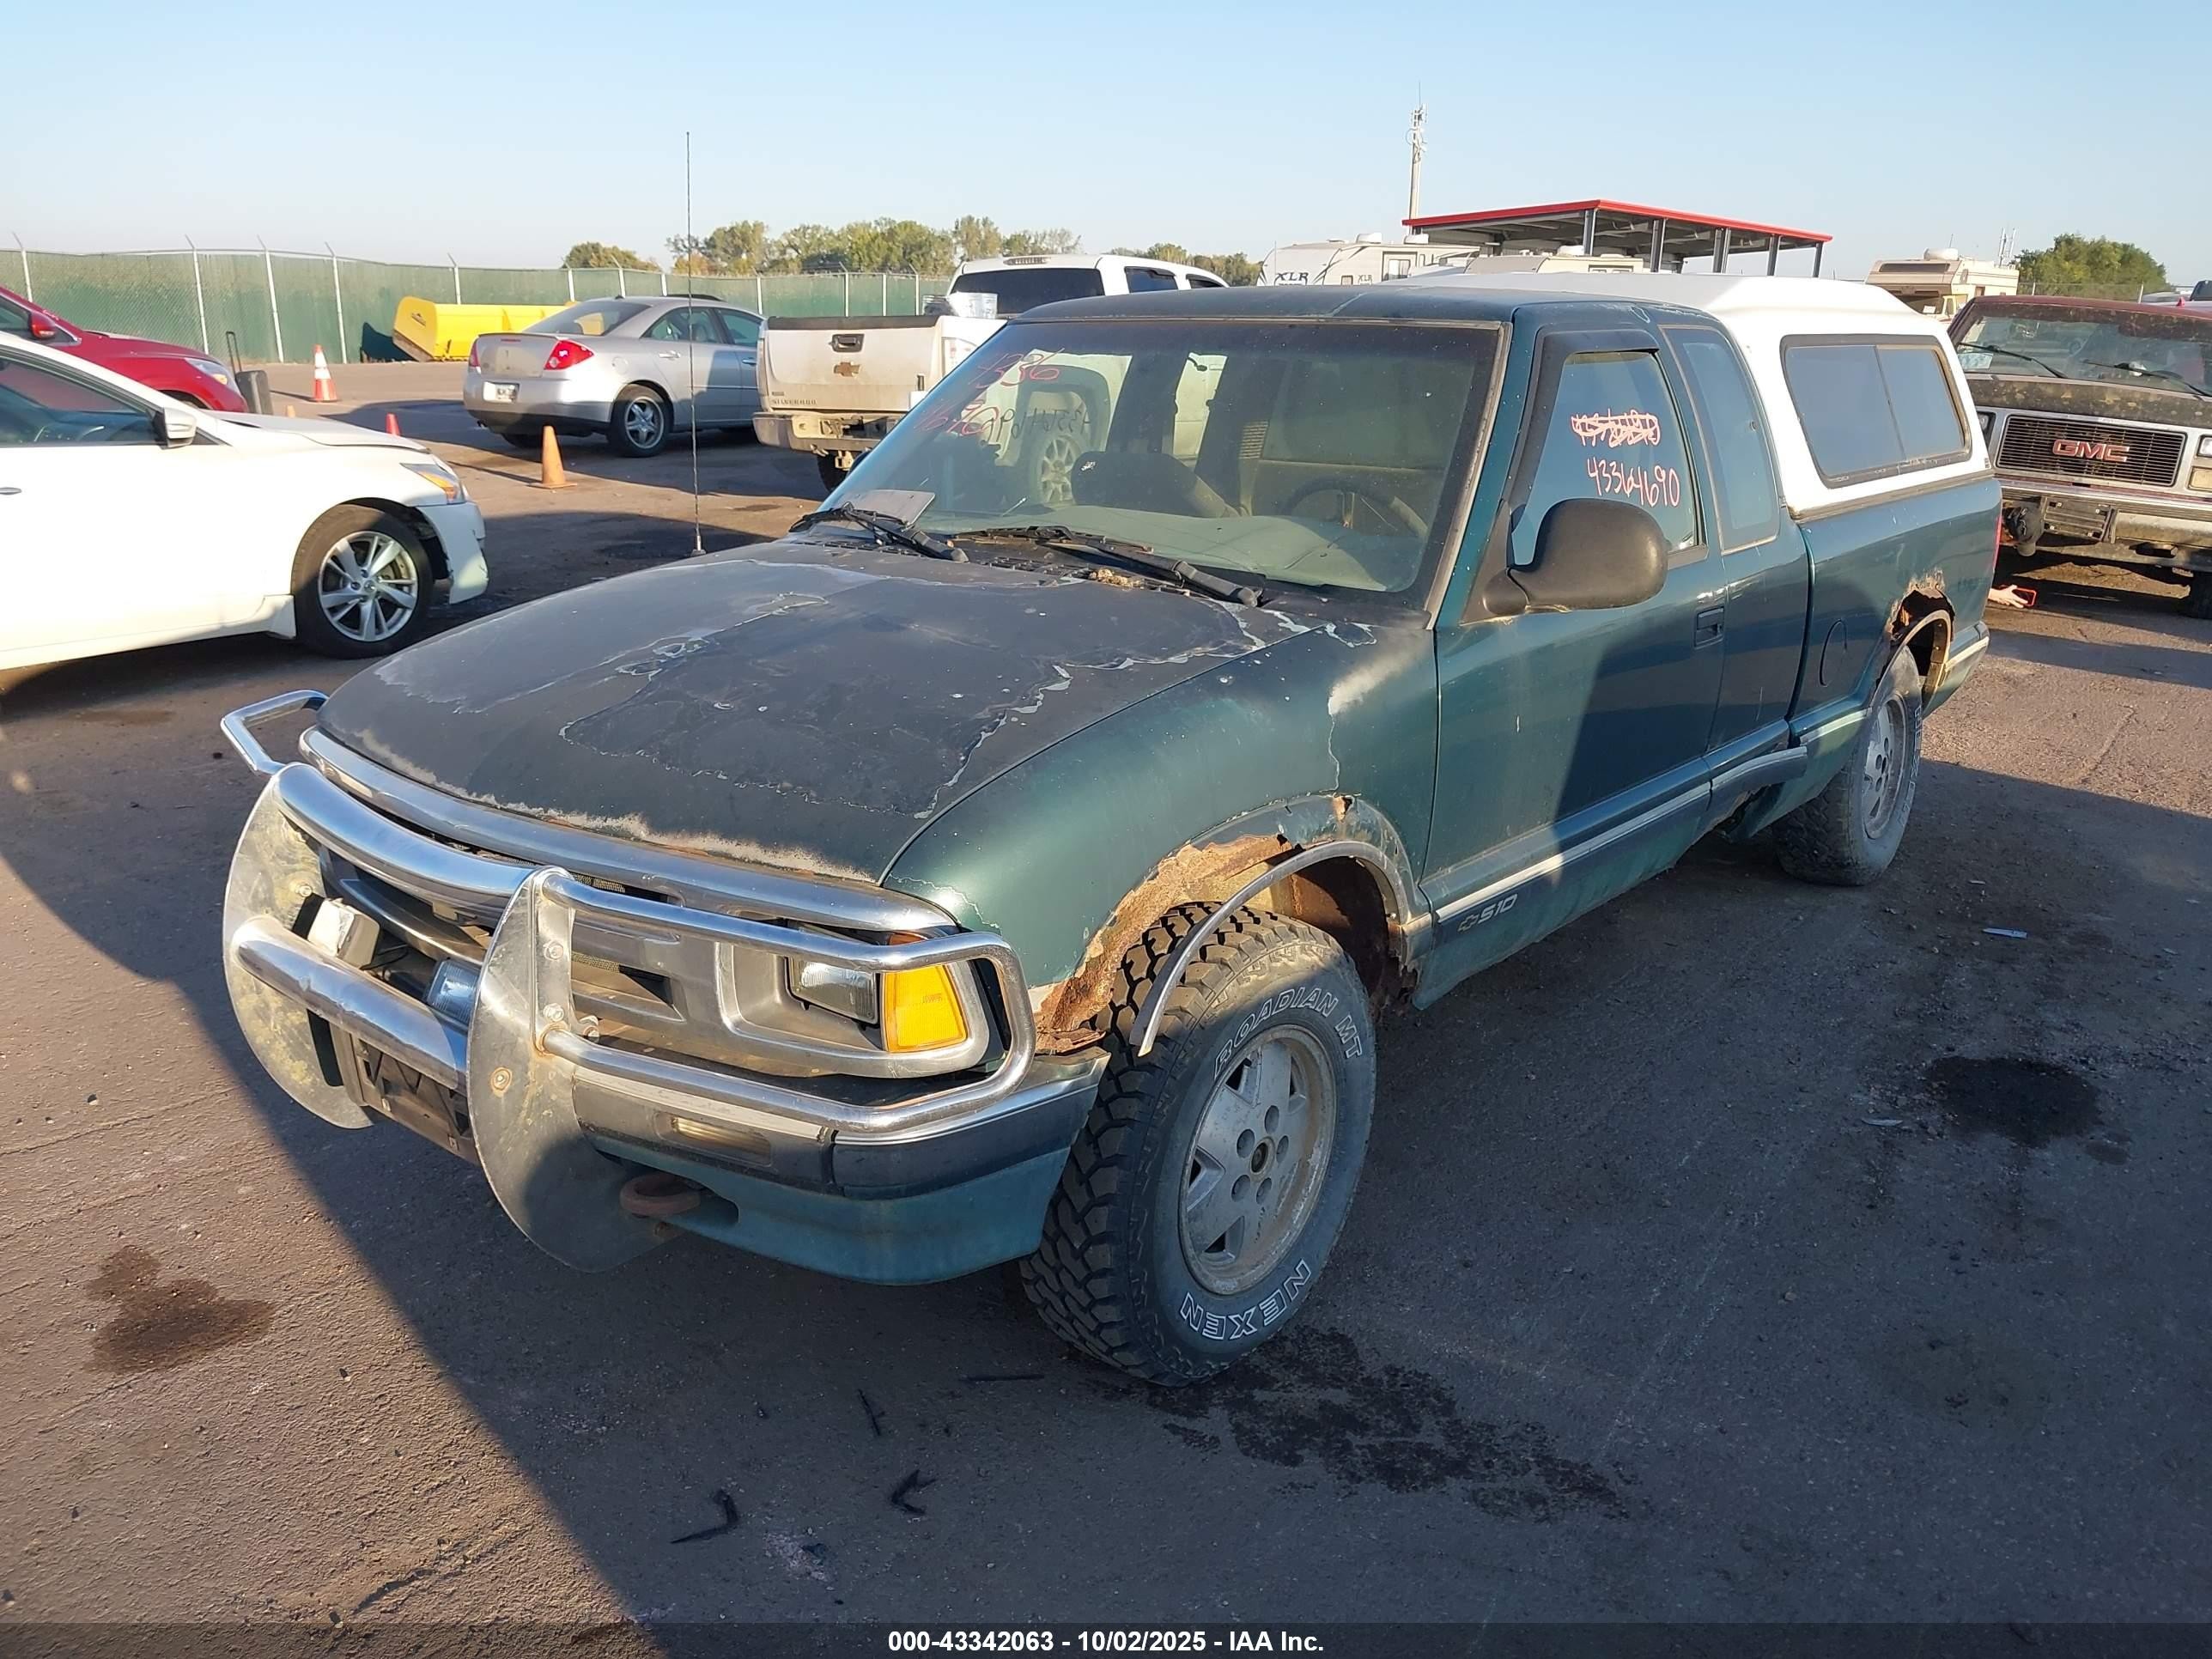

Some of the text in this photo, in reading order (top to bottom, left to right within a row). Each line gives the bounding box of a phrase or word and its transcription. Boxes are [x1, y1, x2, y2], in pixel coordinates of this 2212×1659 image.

[1275, 271, 1310, 283] XLR
[2052, 439, 2130, 462] GMC
[1587, 457, 1680, 507] 43364690
[1478, 893, 1517, 924] S10
[1213, 987, 1363, 1080] ROADIAN MT
[1180, 1258, 1311, 1340] NEXEN
